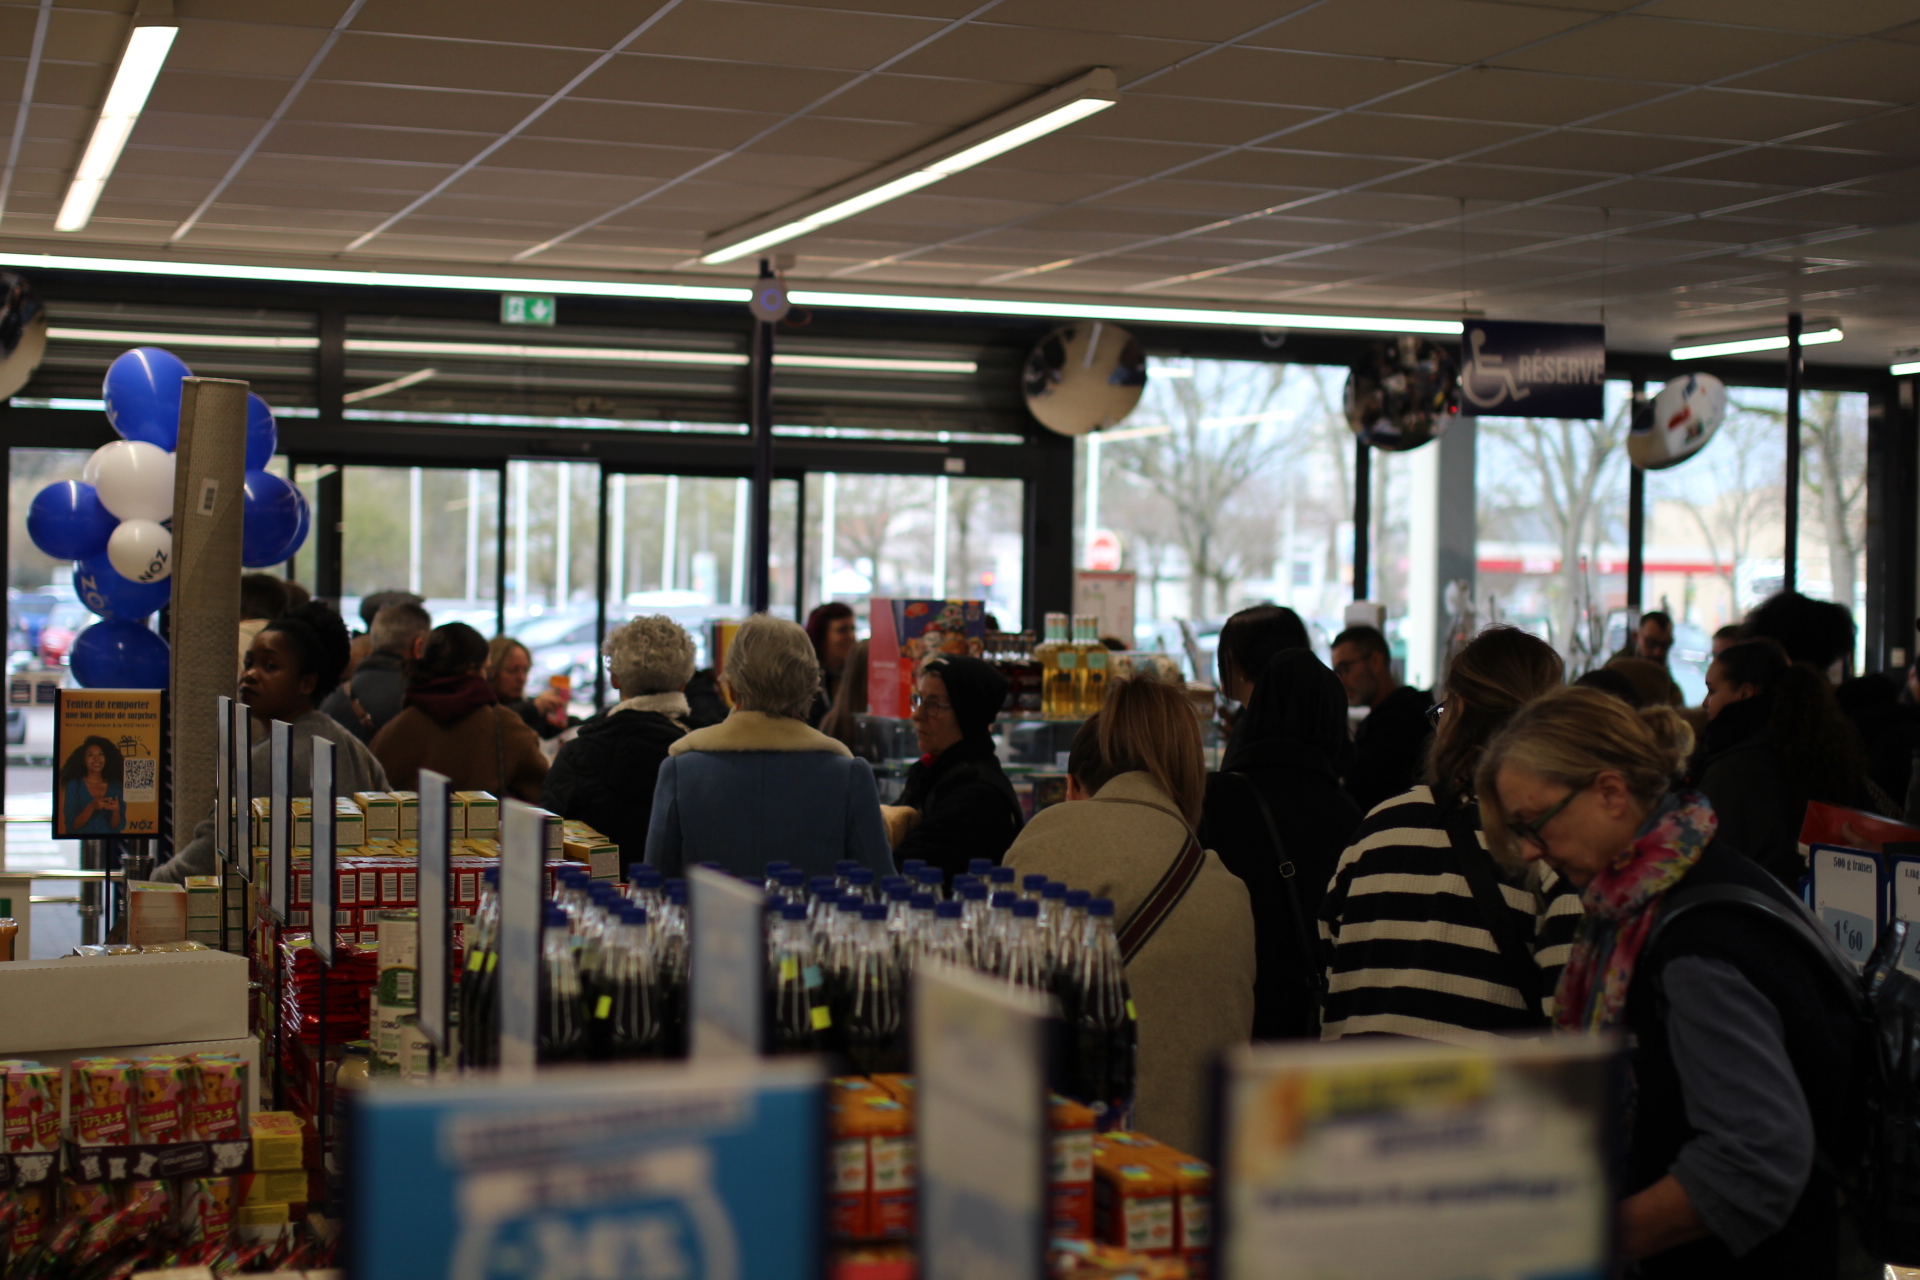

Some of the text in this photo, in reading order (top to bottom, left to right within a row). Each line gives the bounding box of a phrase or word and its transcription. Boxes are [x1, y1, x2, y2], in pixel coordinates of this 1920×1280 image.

[138, 549, 168, 584] NOZ
[65, 699, 150, 710] Tentez de remporter
[80, 711, 92, 719] box
[94, 711, 116, 720] pleine
[117, 711, 126, 719] de
[128, 712, 157, 720] surprises
[1833, 856, 1873, 874] 500 g fraises
